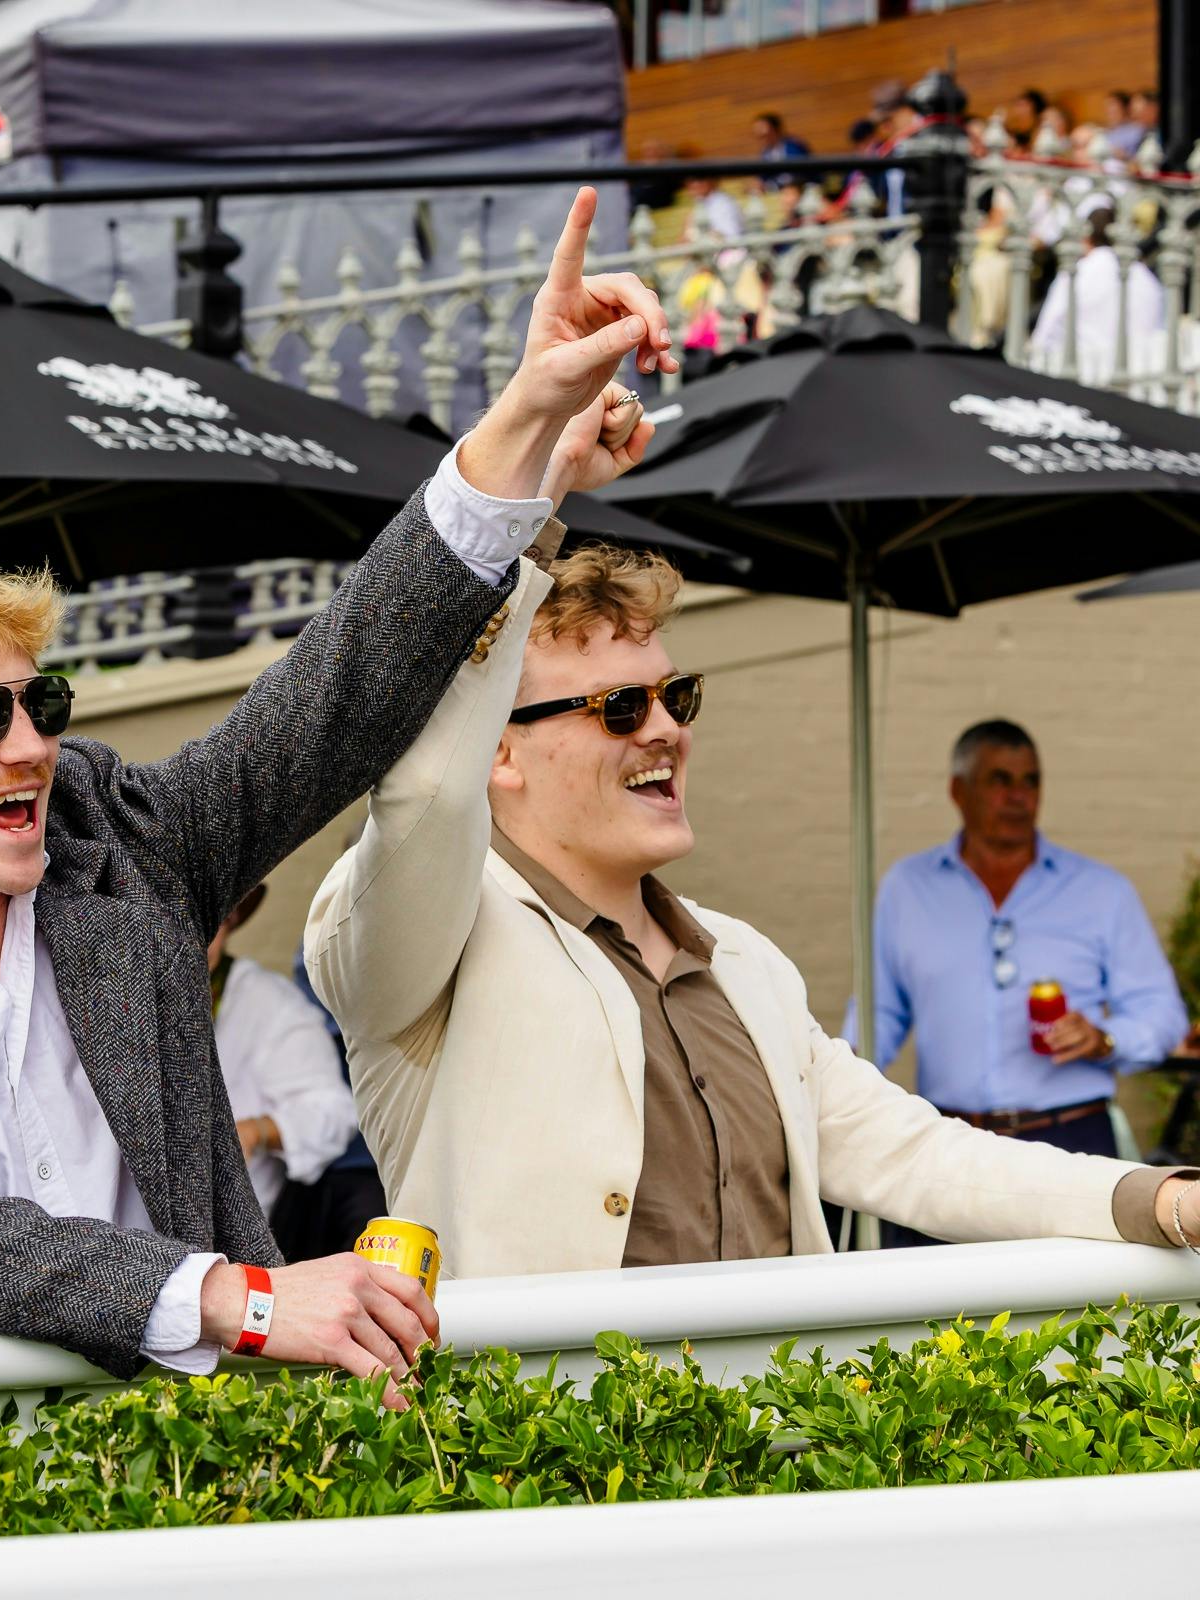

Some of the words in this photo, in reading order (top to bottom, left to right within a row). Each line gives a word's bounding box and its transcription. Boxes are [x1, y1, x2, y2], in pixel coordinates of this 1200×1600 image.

[67, 415, 335, 458] BRISBANE
[91, 434, 252, 456] RACING
[358, 1236, 399, 1250] XXXX
